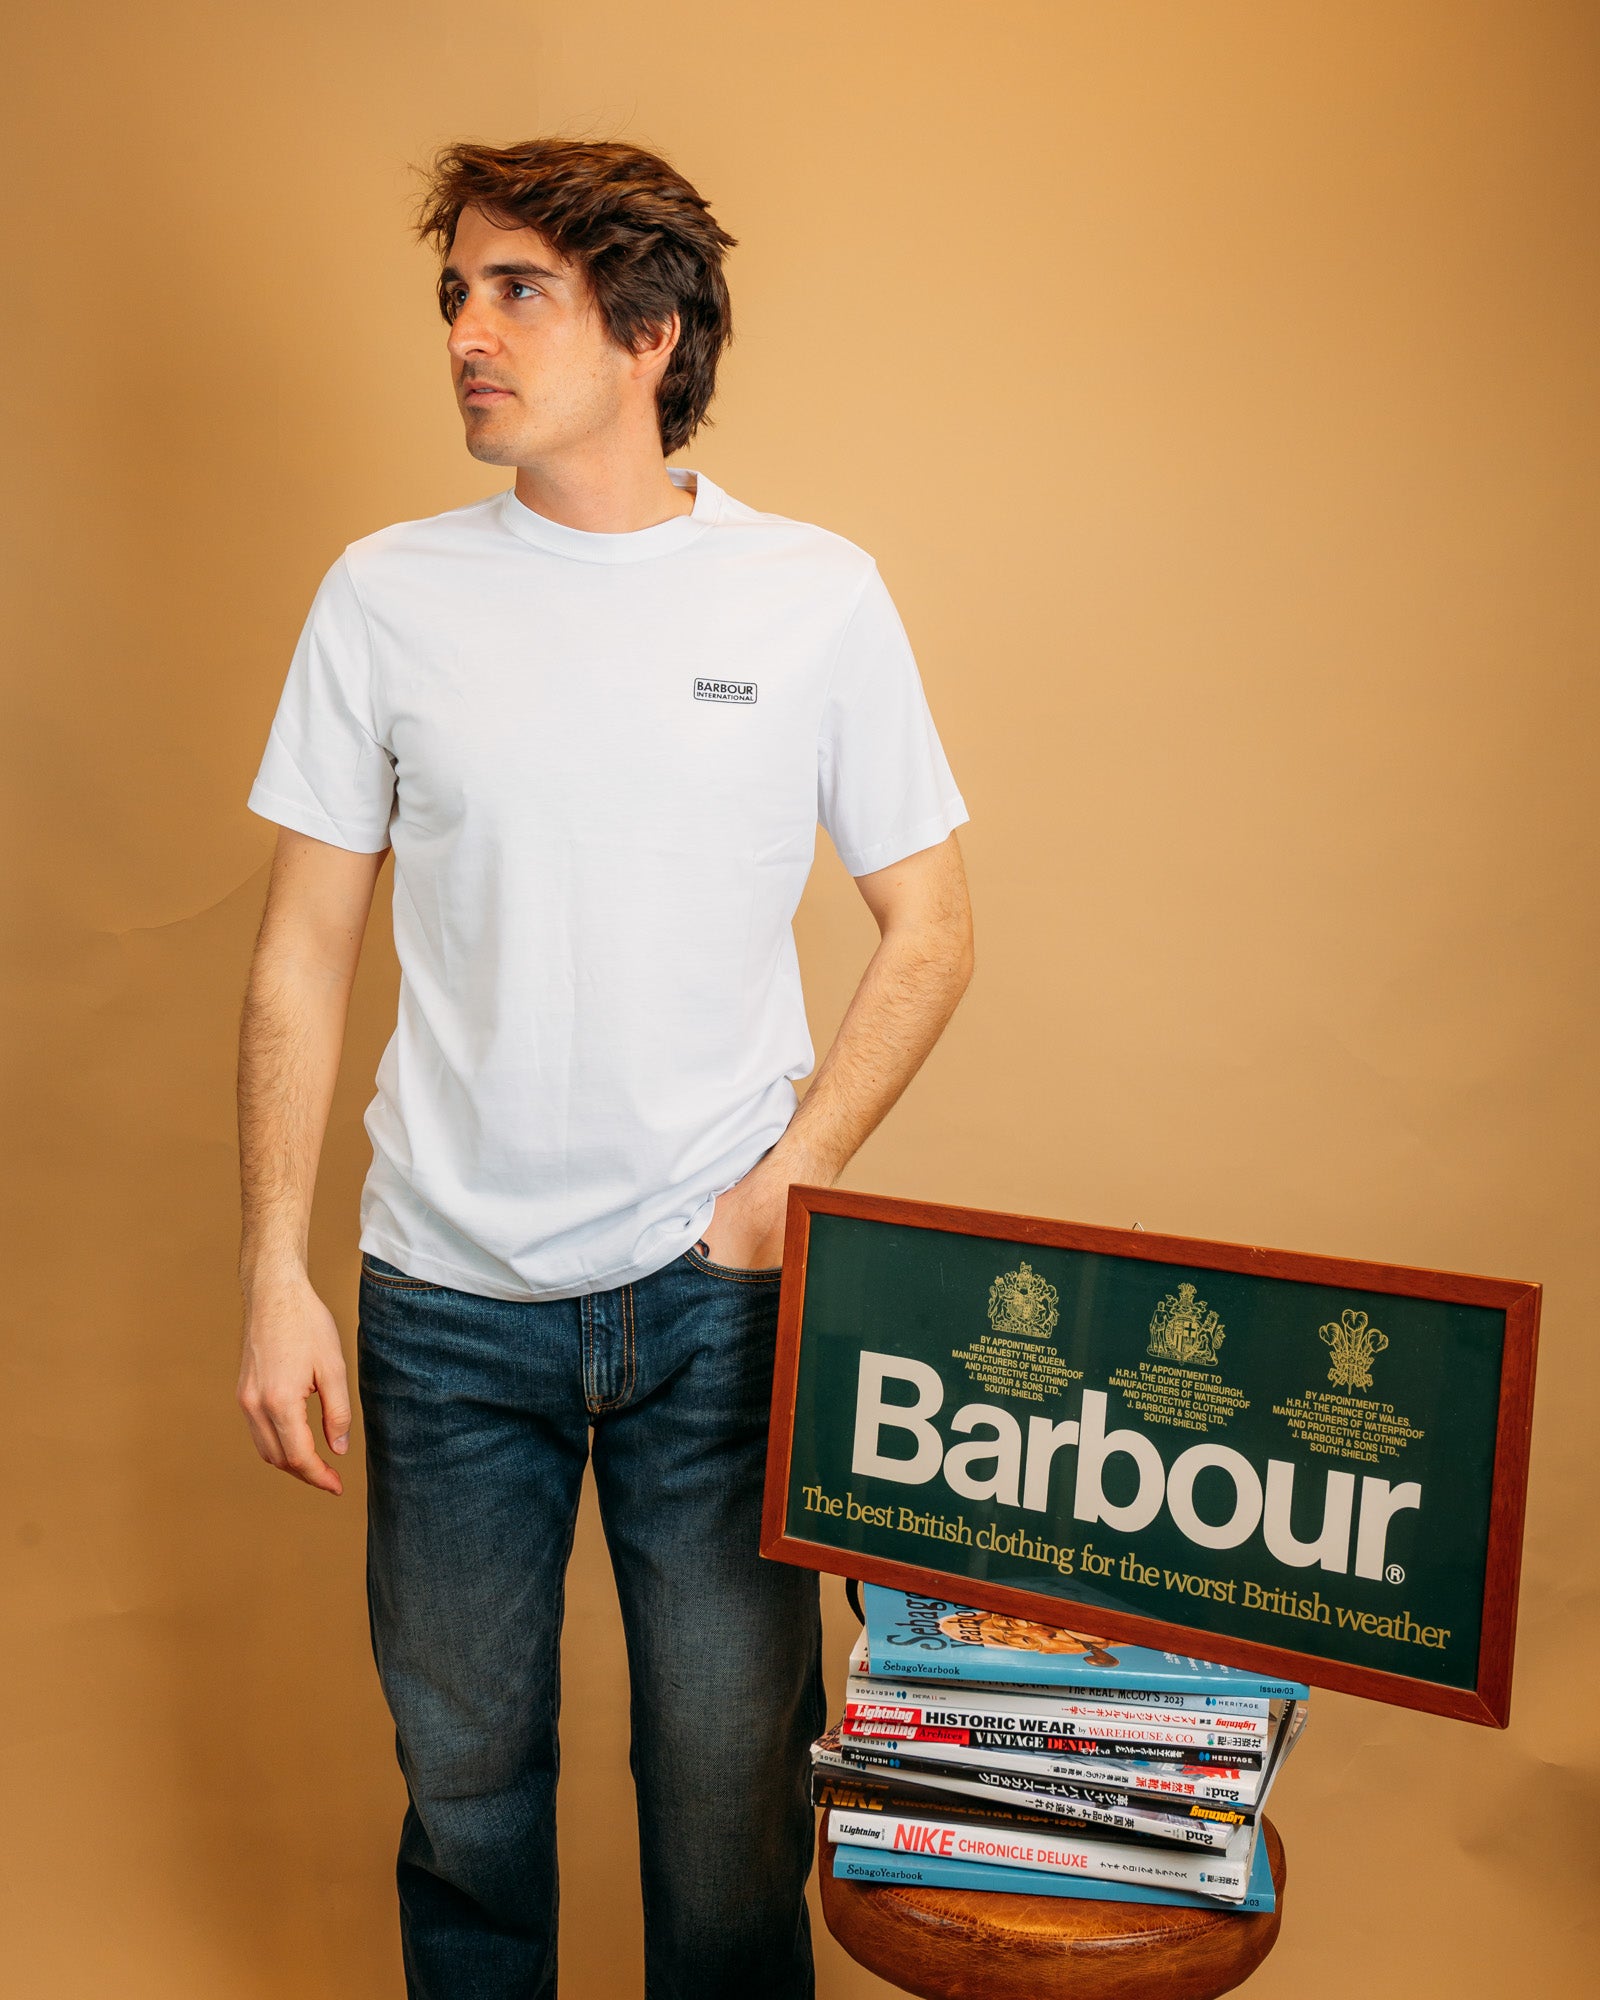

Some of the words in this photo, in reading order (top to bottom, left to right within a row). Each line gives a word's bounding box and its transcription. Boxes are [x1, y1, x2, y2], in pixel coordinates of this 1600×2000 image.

[696, 691, 754, 702] INTERNATIONAL
[697, 681, 753, 695] BARBOUR
[970, 1344, 985, 1353] HER
[986, 1345, 1020, 1358] MAJESTY
[1022, 1352, 1037, 1362] THE
[981, 1336, 991, 1344] BY
[992, 1338, 1045, 1353] APPOINTMENT
[1047, 1346, 1057, 1356] TO
[952, 1349, 1018, 1368] MANUFACTURERS
[1019, 1362, 1029, 1370] OF
[1031, 1363, 1084, 1379] WATERPROOF
[1140, 1362, 1150, 1372] BY
[1152, 1365, 1209, 1381] APPOINTMENT
[1211, 1374, 1222, 1384] TO
[965, 1362, 980, 1371] AND
[982, 1364, 1028, 1380] PROTECTIVE
[1030, 1372, 1068, 1387] CLOTHING
[968, 1372, 976, 1380] J.
[977, 1373, 1014, 1387] BARBOUR
[1022, 1382, 1044, 1392] SONS
[1116, 1368, 1139, 1380] H.R.H.
[1141, 1372, 1156, 1382] THE
[1158, 1376, 1180, 1386] DUKE
[1182, 1380, 1192, 1388] OF
[1194, 1381, 1244, 1398] EDINBURGH.
[984, 1384, 1010, 1396] SOUTH
[1011, 1388, 1044, 1402] SHIELDS.
[1108, 1376, 1180, 1396] MANUFACTURERS
[1181, 1390, 1192, 1398] OF
[1194, 1392, 1250, 1409] WATERPROOF
[1122, 1389, 1140, 1399] AND
[1142, 1392, 1190, 1408] PROTECTIVE
[1192, 1402, 1234, 1416] CLOTHING
[1306, 1391, 1318, 1400] BY
[1319, 1393, 1380, 1410] APPOINTMENT
[1382, 1403, 1394, 1414] TO
[1127, 1400, 1134, 1409] J.
[1136, 1402, 1174, 1416] BARBOUR
[1184, 1410, 1206, 1422] SONS
[1286, 1398, 1311, 1410] H.R.H.
[1313, 1402, 1329, 1412] THE
[1332, 1406, 1363, 1419] PRINCE
[1365, 1411, 1377, 1420] OF
[1379, 1414, 1410, 1427] WALES.
[1144, 1412, 1171, 1425] SOUTH
[1172, 1417, 1208, 1432] SHIELDS.
[1272, 1405, 1348, 1427] MANUFACTURERS
[1350, 1418, 1362, 1428] OF
[1364, 1422, 1424, 1439] WATERPROOF
[1288, 1418, 1306, 1429] AND
[1308, 1422, 1360, 1439] PROTECTIVE
[1362, 1431, 1406, 1447] CLOTHING
[1292, 1430, 1299, 1438] J.
[1302, 1431, 1344, 1446] BARBOUR
[1346, 1438, 1352, 1447] &
[1354, 1440, 1378, 1452] SONS
[1310, 1442, 1339, 1456] SOUTH
[1341, 1448, 1380, 1463] SHIELDS.
[852, 1350, 1422, 1582] Barbour
[802, 1486, 842, 1517] The
[846, 1492, 894, 1528] best
[898, 1507, 973, 1546] British
[976, 1523, 1074, 1574] clothing
[1080, 1543, 1115, 1577] for
[1119, 1552, 1160, 1587] the
[1163, 1569, 1236, 1604] worst
[1242, 1580, 1332, 1624] British
[1336, 1606, 1451, 1650] weather
[856, 1688, 894, 1696] HERITAGE
[1164, 1696, 1184, 1706] 2023
[855, 1704, 914, 1723] Lightning
[1219, 1700, 1258, 1709] HERITAGE
[852, 1720, 918, 1739] Lightning
[919, 1729, 962, 1740] Archives
[926, 1712, 1017, 1730] HISTORIC
[1020, 1716, 1075, 1735] WEAR
[1088, 1726, 1163, 1741] WAREHOUSE
[1165, 1734, 1173, 1742] &
[1176, 1734, 1195, 1744] CO.
[1216, 1718, 1256, 1731] Lightning
[848, 1736, 886, 1746] HERITAGE
[976, 1731, 1044, 1748] VINTAGE
[1048, 1738, 1096, 1752] DENIM
[820, 1754, 855, 1766] HERITAGE
[850, 1754, 888, 1764] HERITAGE
[1212, 1754, 1253, 1764] HERITAGE
[1084, 1790, 1129, 1807] 革ジャン
[1211, 1788, 1239, 1801] 2nd
[1189, 1804, 1246, 1824] Lightning
[844, 1825, 880, 1839] Lightning
[1186, 1830, 1213, 1845] 2nd
[894, 1824, 956, 1856] NIKE
[958, 1839, 1034, 1861] CHRONICLE
[1037, 1850, 1088, 1869] DELUXE
[846, 1864, 922, 1880] SebagoYearbook
[1100, 1861, 1120, 1870] ナイキ
[1122, 1864, 1154, 1875] クロニクル
[1155, 1868, 1188, 1879] デラックス
